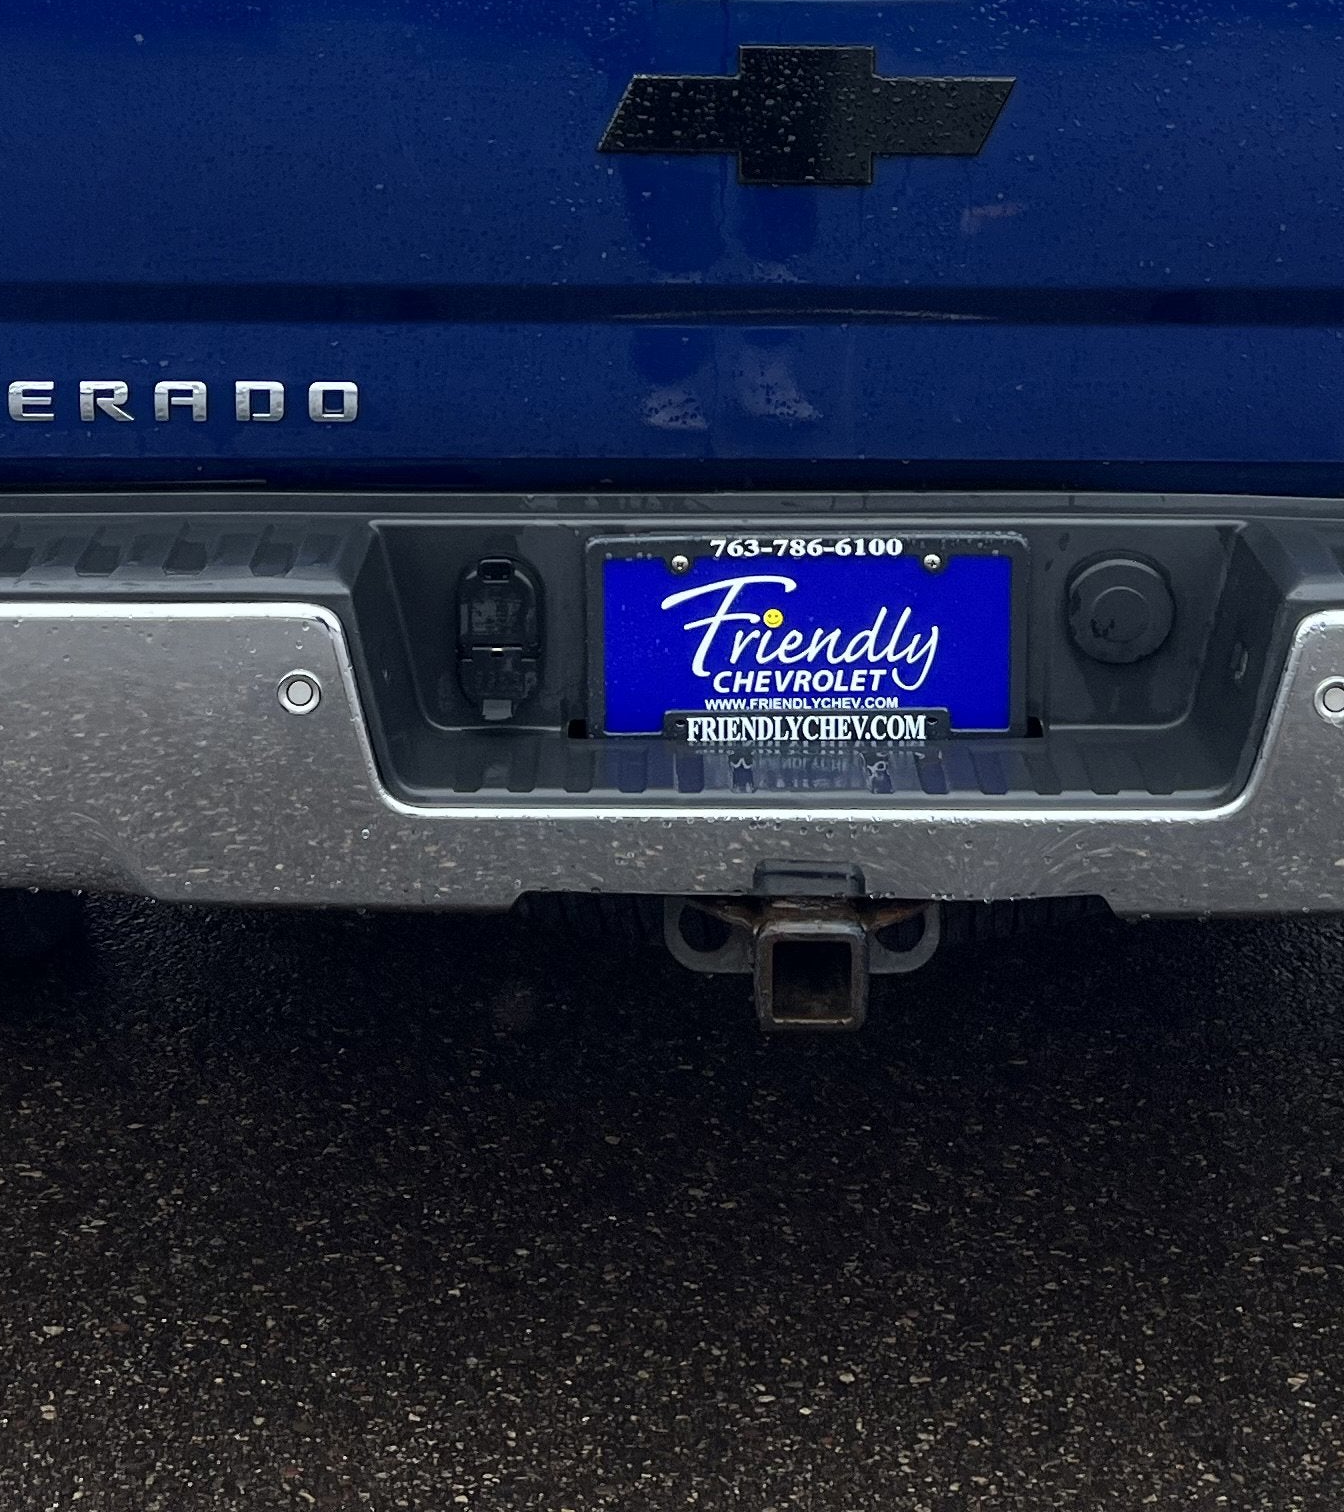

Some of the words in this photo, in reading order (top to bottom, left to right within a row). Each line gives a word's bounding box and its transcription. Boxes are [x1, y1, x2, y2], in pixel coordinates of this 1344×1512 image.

[710, 539, 904, 557] 763-786-6100
[661, 575, 939, 691] Friendly
[712, 669, 886, 692] CHEVROLET
[704, 697, 899, 710] WWW.FRIENDLYCHEV.COM
[686, 715, 927, 742] FRIENDLYCHEV.COM
